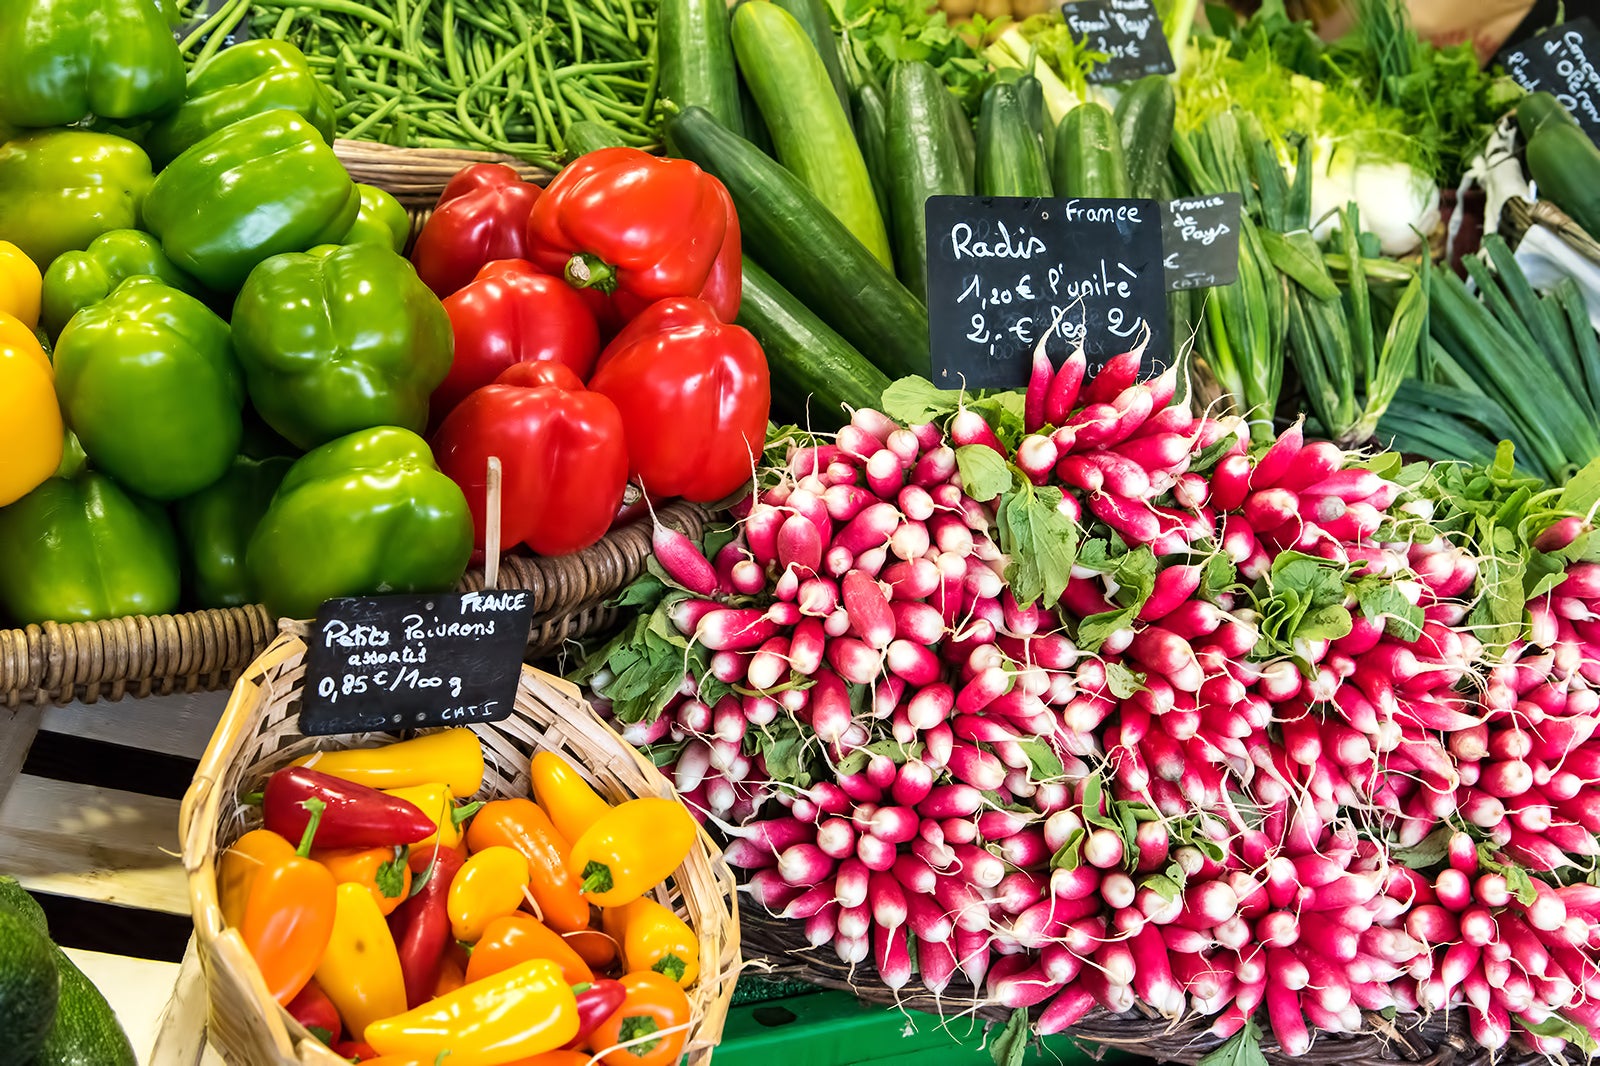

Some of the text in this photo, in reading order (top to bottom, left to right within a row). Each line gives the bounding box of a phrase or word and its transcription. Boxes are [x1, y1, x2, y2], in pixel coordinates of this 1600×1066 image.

[1065, 199, 1143, 223] France
[1169, 196, 1225, 213] France
[1173, 212, 1198, 228] de
[951, 220, 1047, 260] Radis
[1181, 223, 1231, 246] Pays
[1107, 307, 1142, 338] 2
[460, 591, 527, 615] FRANCE
